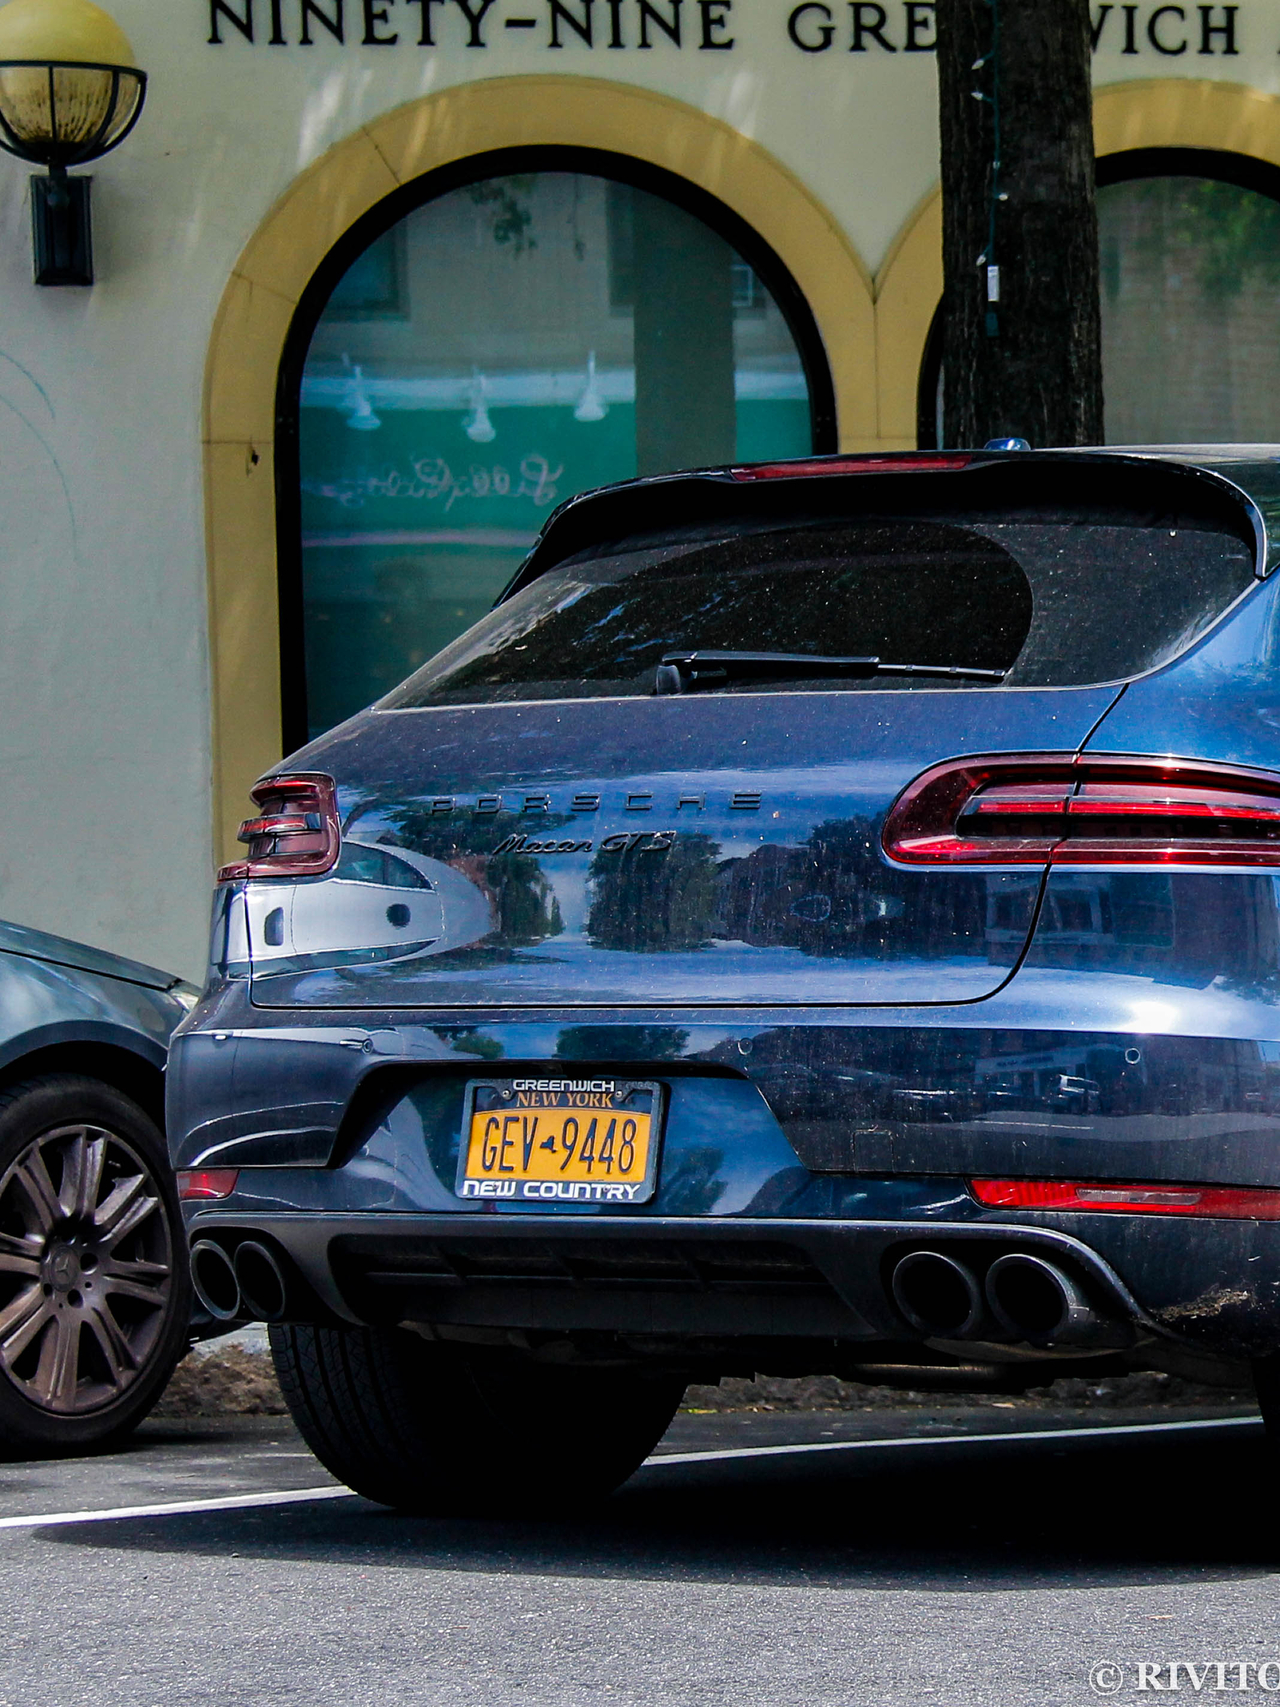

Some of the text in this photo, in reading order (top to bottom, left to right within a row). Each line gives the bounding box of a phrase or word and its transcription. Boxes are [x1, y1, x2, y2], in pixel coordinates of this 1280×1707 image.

[207, 0, 735, 49] NINETY-NINE
[787, 1, 1239, 54] GREICH
[430, 792, 762, 816] PORSCHE
[493, 830, 677, 855] Macan GTS
[512, 1079, 615, 1092] GREENWICH
[516, 1091, 613, 1108] NEW YORK
[462, 1180, 641, 1200] NEW COUNTRY
